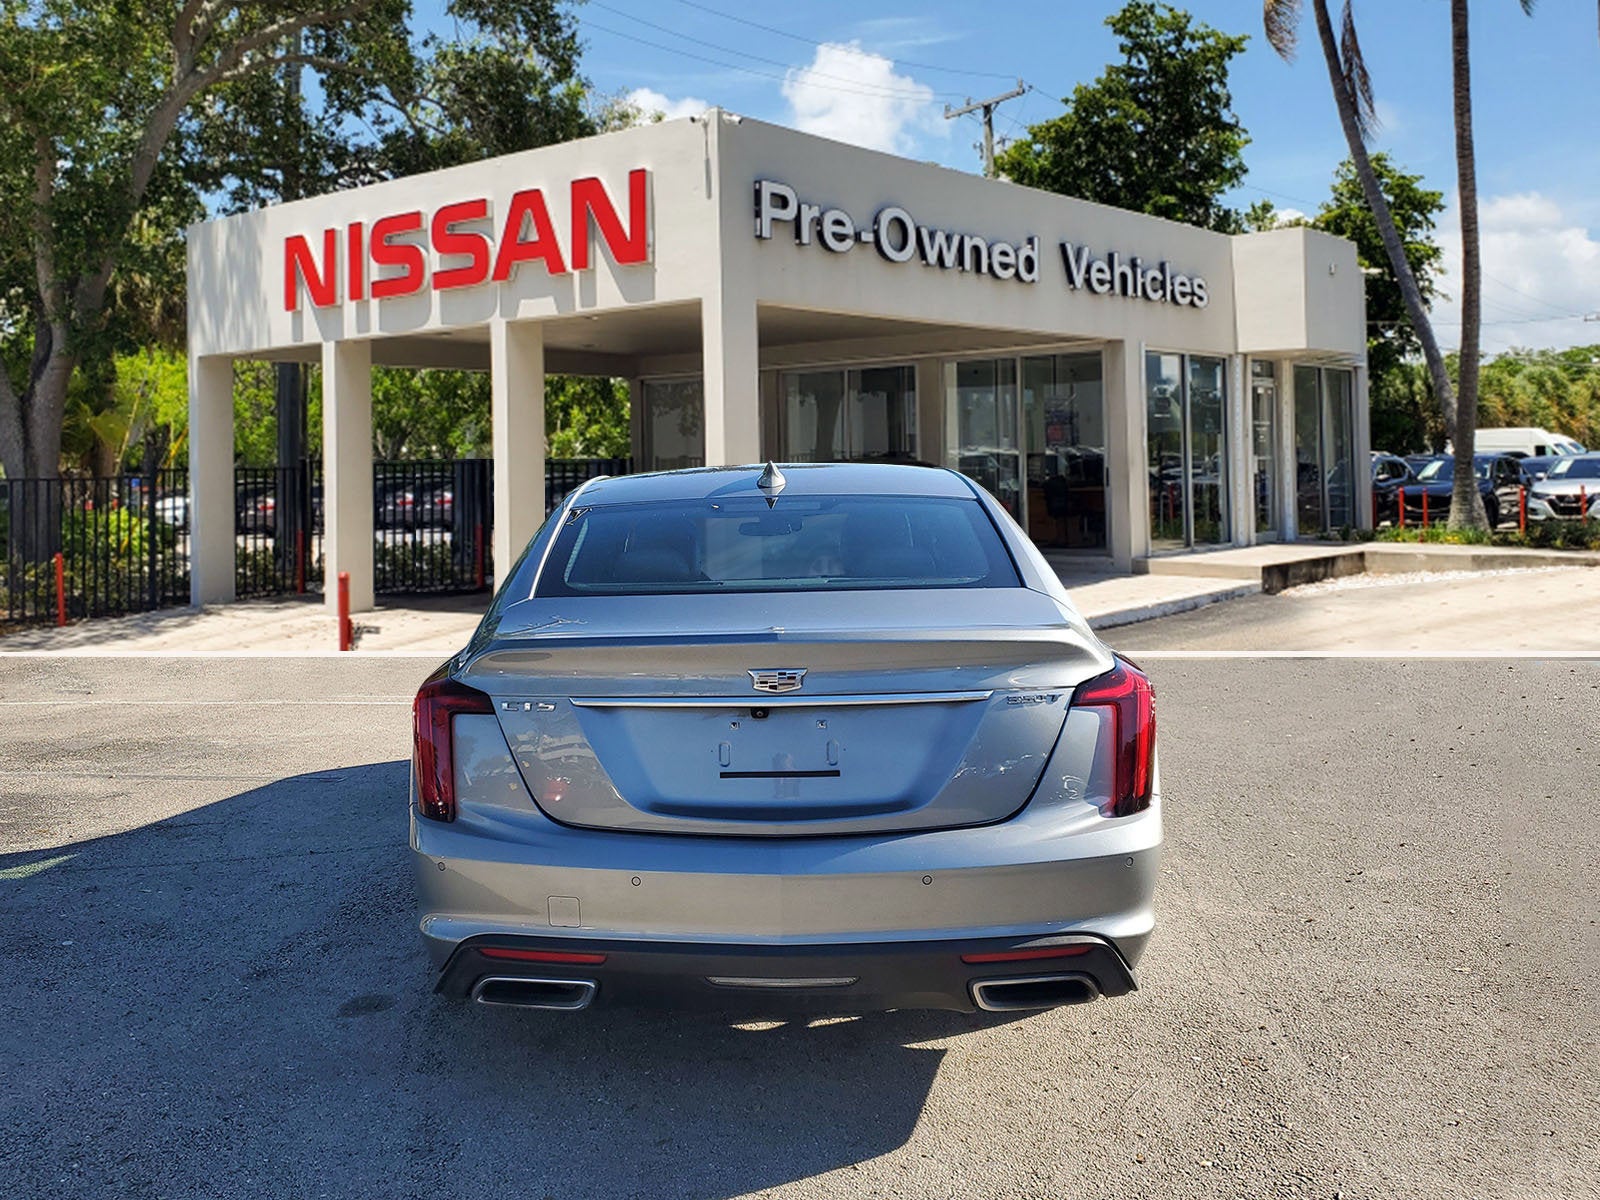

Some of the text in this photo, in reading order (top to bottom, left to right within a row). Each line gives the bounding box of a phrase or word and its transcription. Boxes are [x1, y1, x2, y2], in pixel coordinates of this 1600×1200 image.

[285, 168, 647, 312] NISSAN
[754, 179, 1208, 308] Pre-Owned Vehicles
